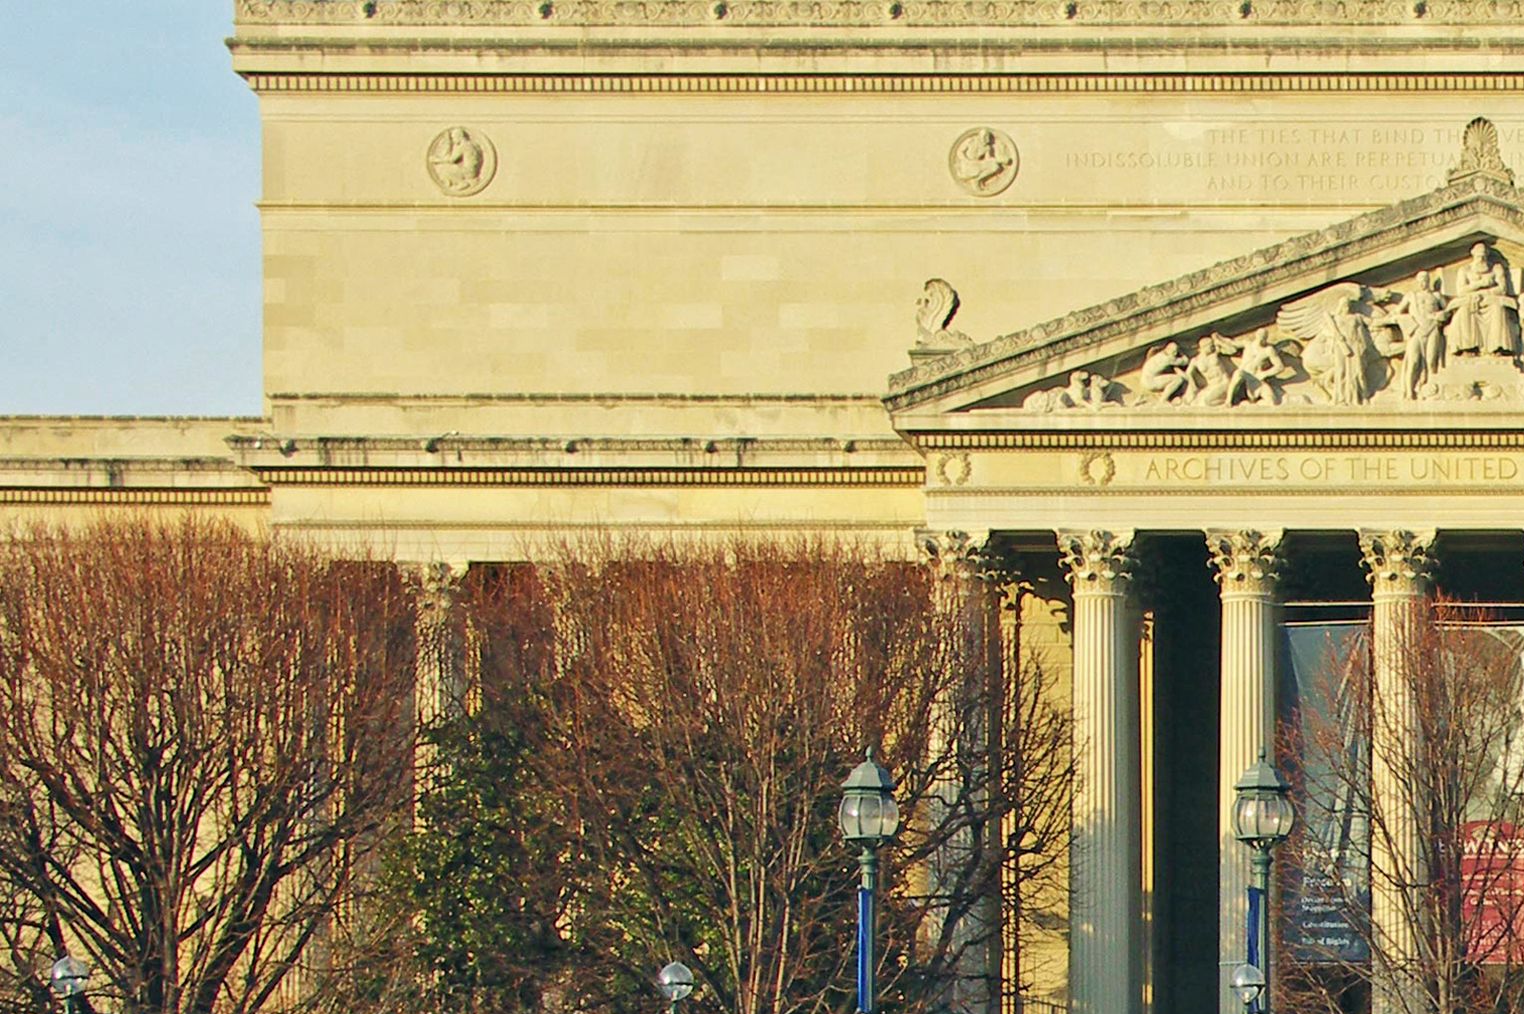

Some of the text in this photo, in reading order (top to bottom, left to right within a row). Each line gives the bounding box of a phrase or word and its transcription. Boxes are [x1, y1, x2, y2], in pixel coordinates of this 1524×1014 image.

[1207, 129, 1249, 145] THE
[1260, 129, 1301, 145] TIES
[1310, 128, 1362, 145] THAT
[1371, 128, 1425, 145] BIND
[1065, 152, 1217, 168] INDISSOLUBLE
[1225, 152, 1299, 168] UNION
[1307, 152, 1346, 168] ARE
[1207, 175, 1252, 191] AND
[1260, 175, 1289, 191] TO
[1298, 175, 1359, 191] THEIR
[1145, 457, 1290, 480] ARCHIVES
[1300, 457, 1336, 480] OF
[1344, 457, 1399, 480] THE
[1409, 456, 1518, 480] UNITED
